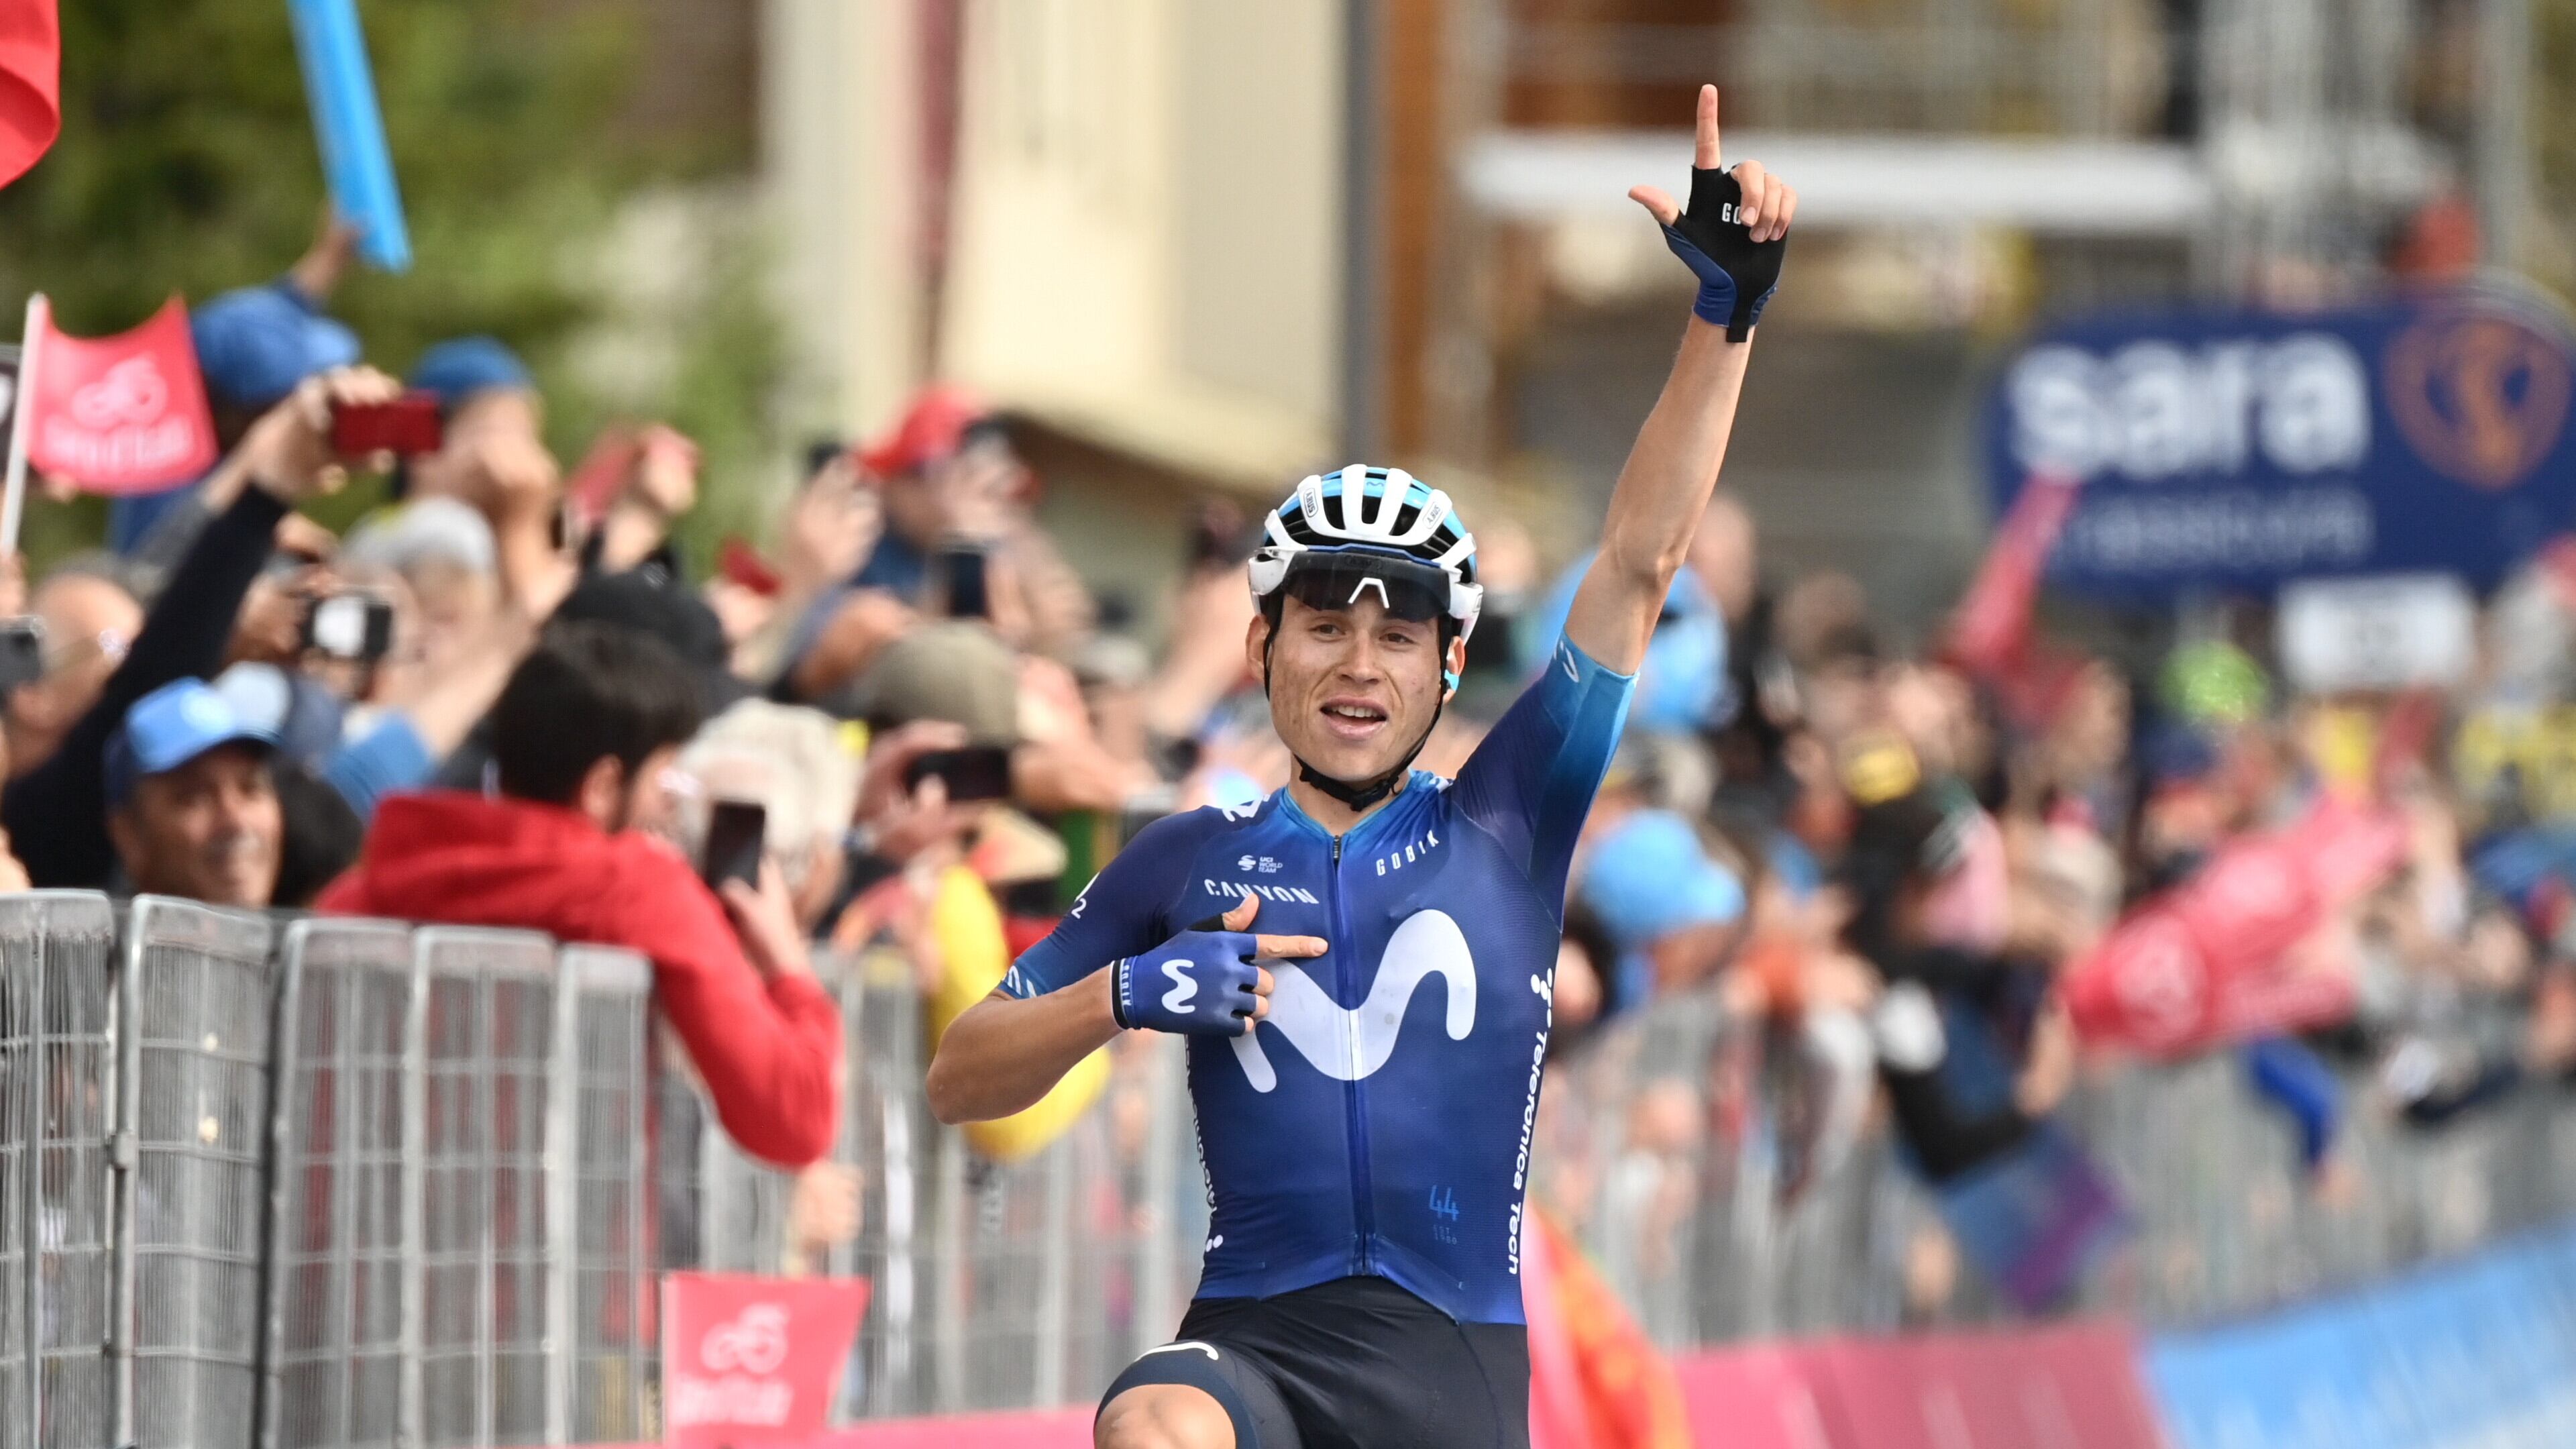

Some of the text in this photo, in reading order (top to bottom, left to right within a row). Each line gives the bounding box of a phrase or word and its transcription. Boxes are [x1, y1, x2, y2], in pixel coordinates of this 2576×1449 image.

[2011, 333, 2370, 483] sara
[1376, 830, 1440, 877] GOBIK
[1204, 879, 1320, 904] CANYON
[1429, 1185, 1459, 1221] 44
[1509, 1202, 1521, 1275] Tech
